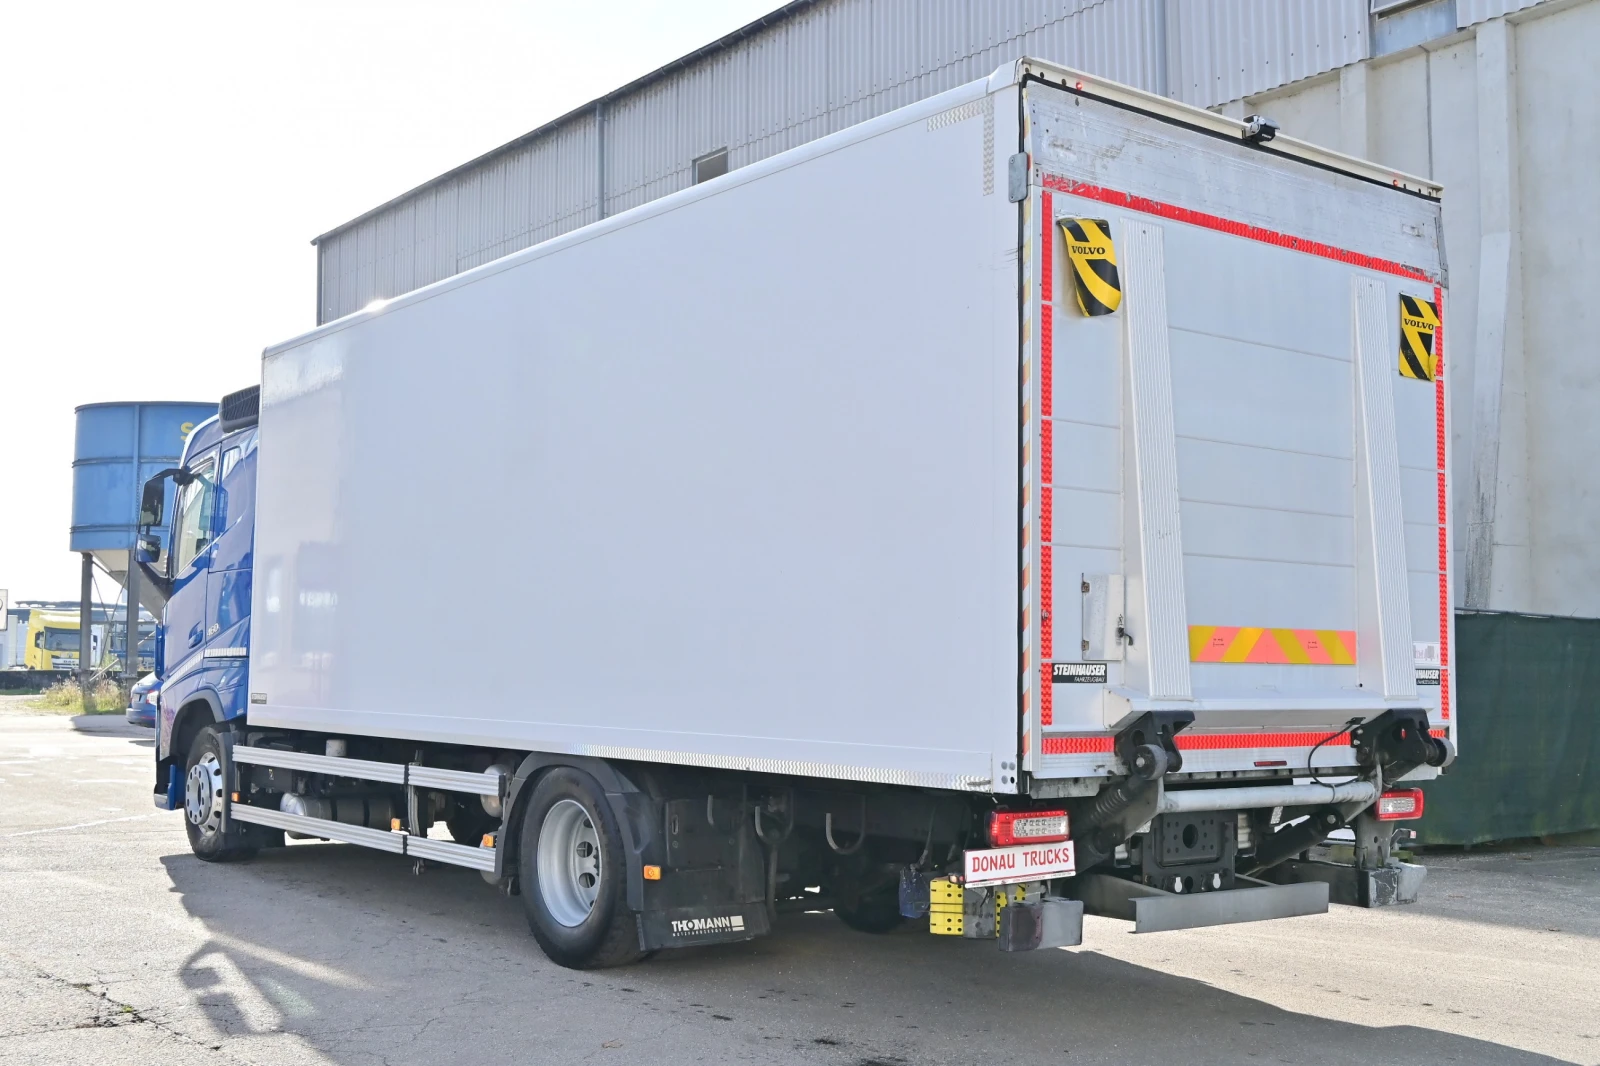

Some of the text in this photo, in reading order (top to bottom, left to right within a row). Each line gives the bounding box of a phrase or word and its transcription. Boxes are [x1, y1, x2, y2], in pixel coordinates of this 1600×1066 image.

[1071, 245, 1106, 255] VOLVO
[1404, 318, 1434, 331] VOLVO
[1053, 664, 1106, 676] STEINHAUSER
[972, 847, 1070, 873] DONAU TRUCKS
[671, 916, 731, 932] THOMANN
